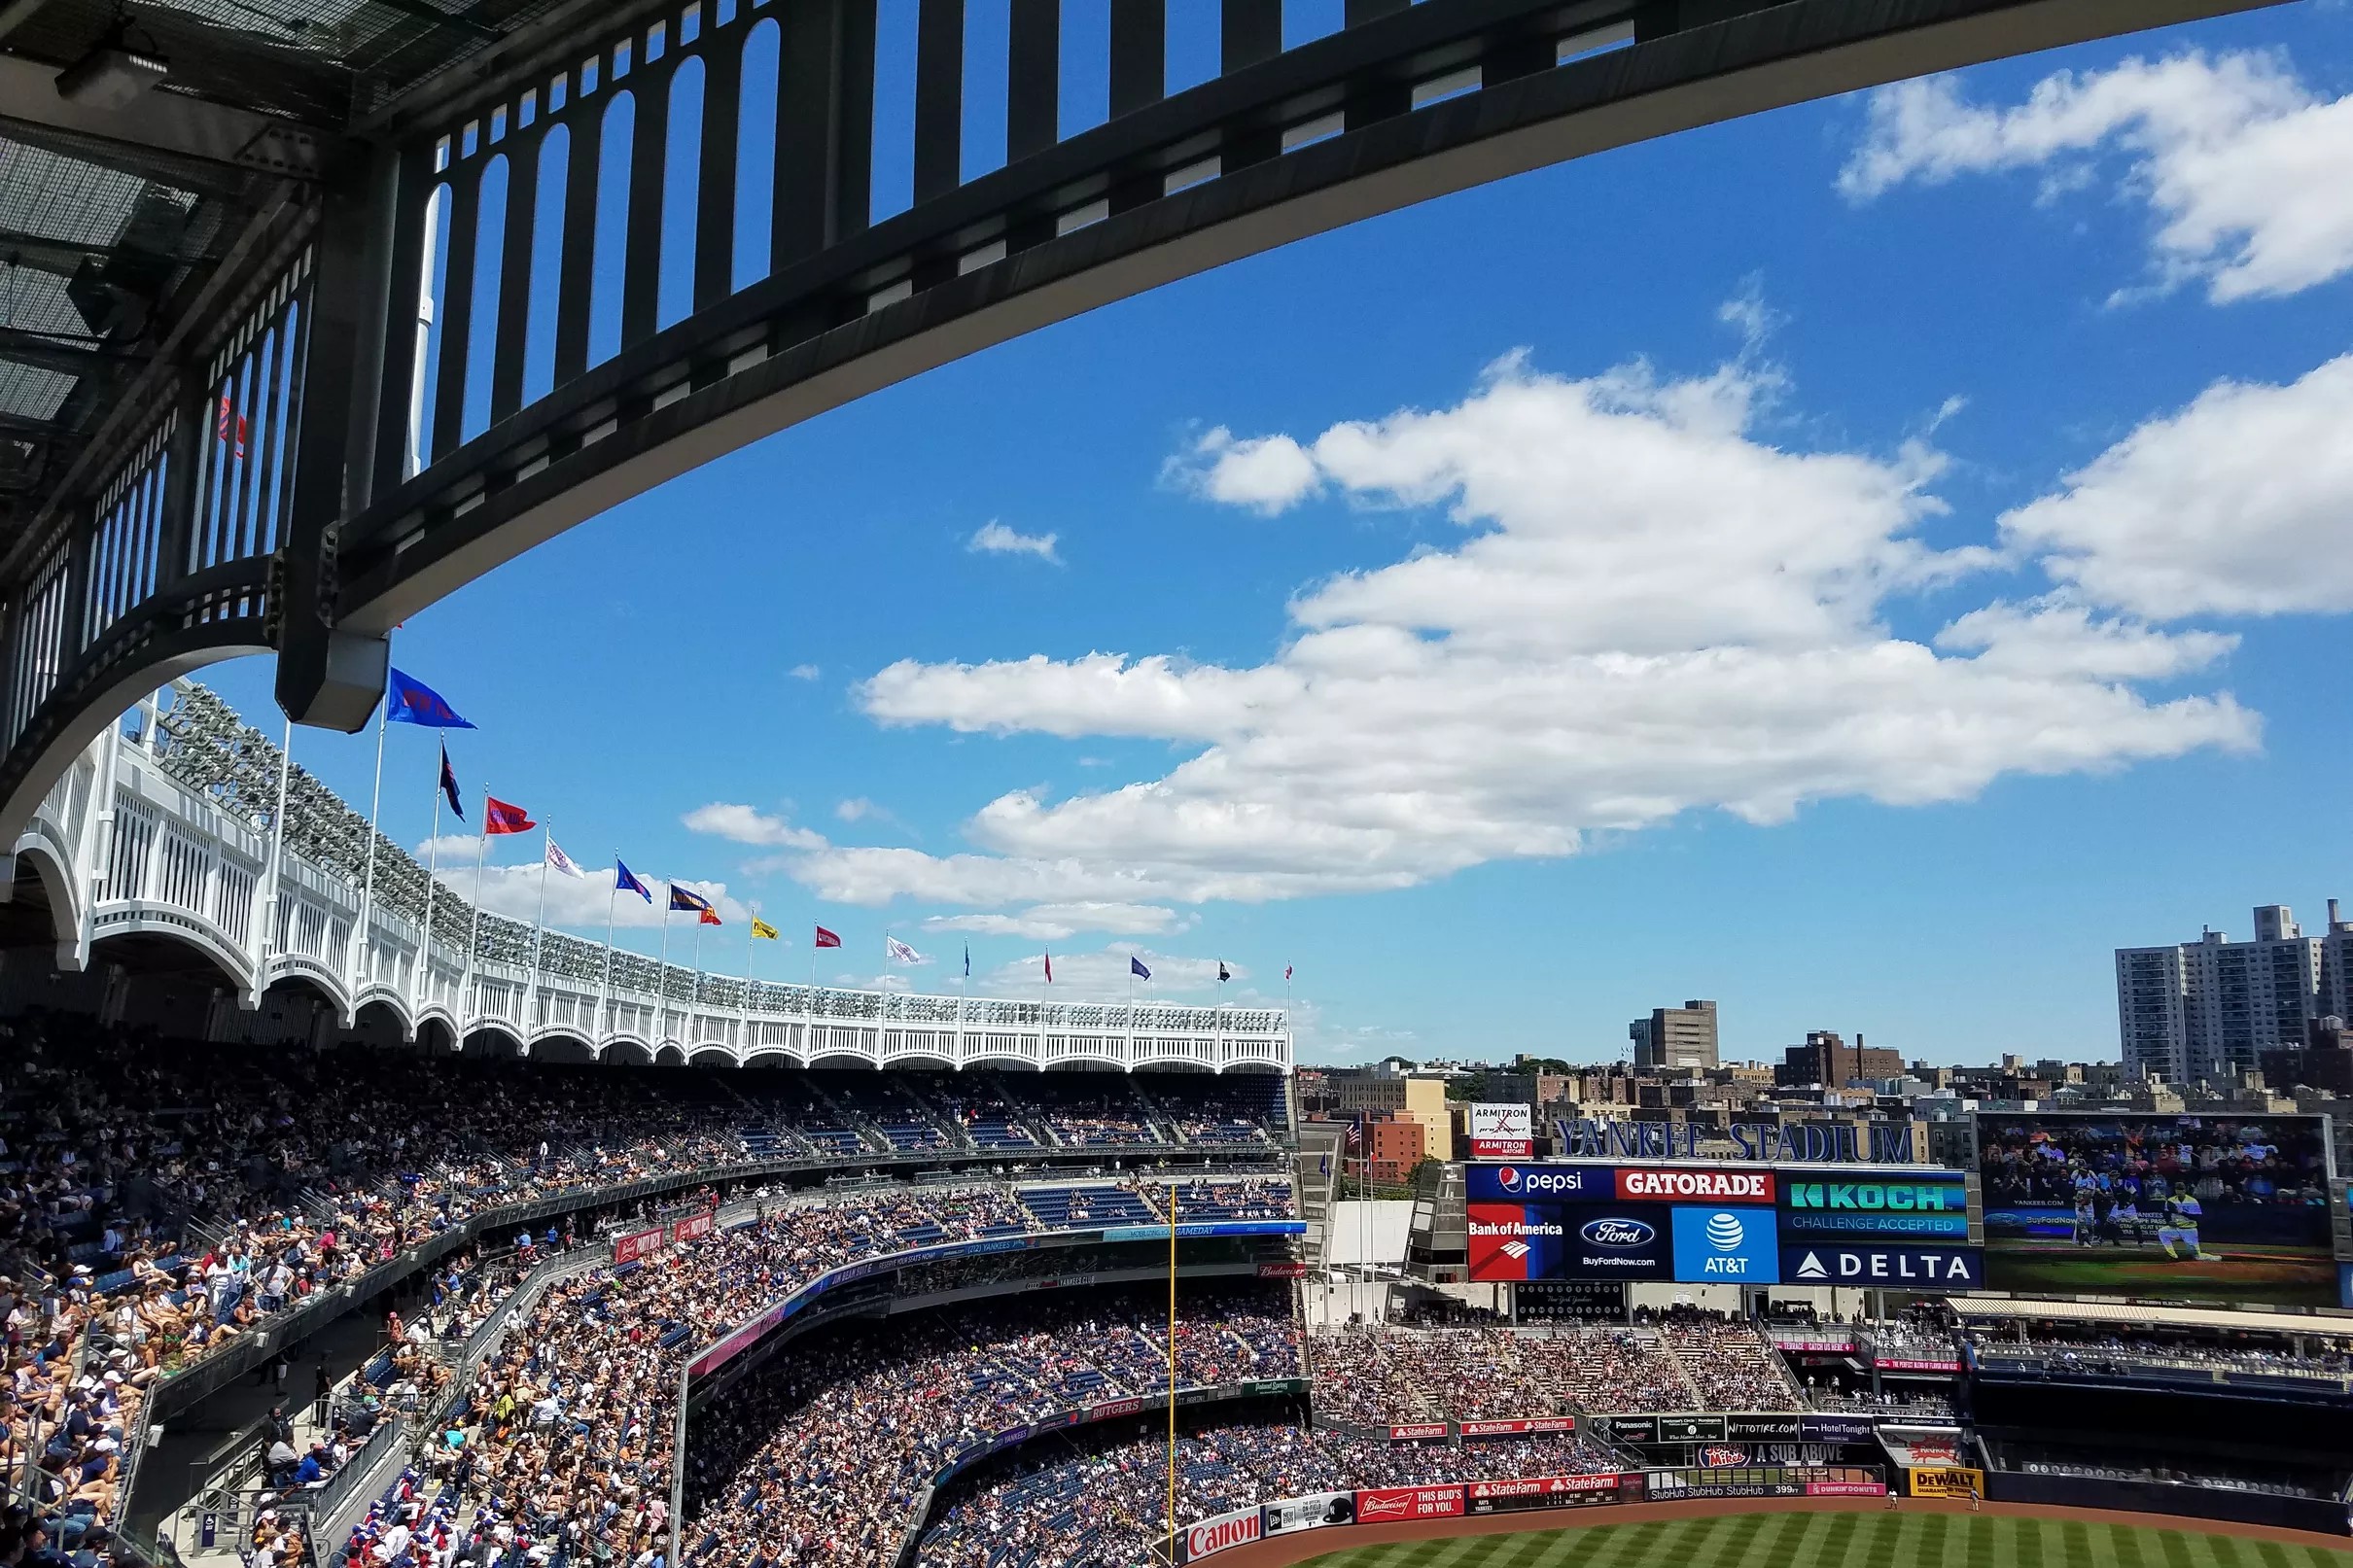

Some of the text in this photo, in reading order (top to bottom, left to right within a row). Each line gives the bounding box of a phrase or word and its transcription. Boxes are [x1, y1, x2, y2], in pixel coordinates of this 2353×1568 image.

[1476, 1109, 1528, 1118] ARMITRON
[1556, 1119, 1915, 1165] YANKEE STADIUM
[1527, 1171, 1582, 1193] pepsi
[1626, 1173, 1765, 1197] GATORADE
[1830, 1184, 1945, 1210] KOCH
[1469, 1222, 1563, 1236] Bank of America
[1793, 1217, 1953, 1232] CHALLENGE ACCEPTED
[1176, 1227, 1215, 1236] GAMEDAY
[1595, 1222, 1640, 1243] Ford
[983, 1241, 1010, 1252] YANKEES
[1583, 1257, 1656, 1268] BuyFordNow.com
[1704, 1257, 1748, 1273] AT&T
[1840, 1253, 1971, 1279] DELTA
[1260, 1266, 1305, 1276] Budweiser
[1272, 1381, 1288, 1390] Spring
[1093, 1400, 1140, 1418] RUTGERS
[1616, 1420, 1652, 1429] Panasonic
[1729, 1423, 1797, 1434] NITTOTIRE.COM
[1705, 1443, 1744, 1455] Jersey
[1757, 1445, 1844, 1461] A SUB ABOVE
[1418, 1488, 1462, 1502] THIS BUD'S
[1652, 1489, 1685, 1499] StubHub
[1688, 1486, 1723, 1497] StubHub
[1727, 1485, 1764, 1495] StubHub
[1364, 1500, 1408, 1511] Budweiser
[1418, 1502, 1454, 1514] FOR YOU.
[1189, 1514, 1259, 1556] Canon
